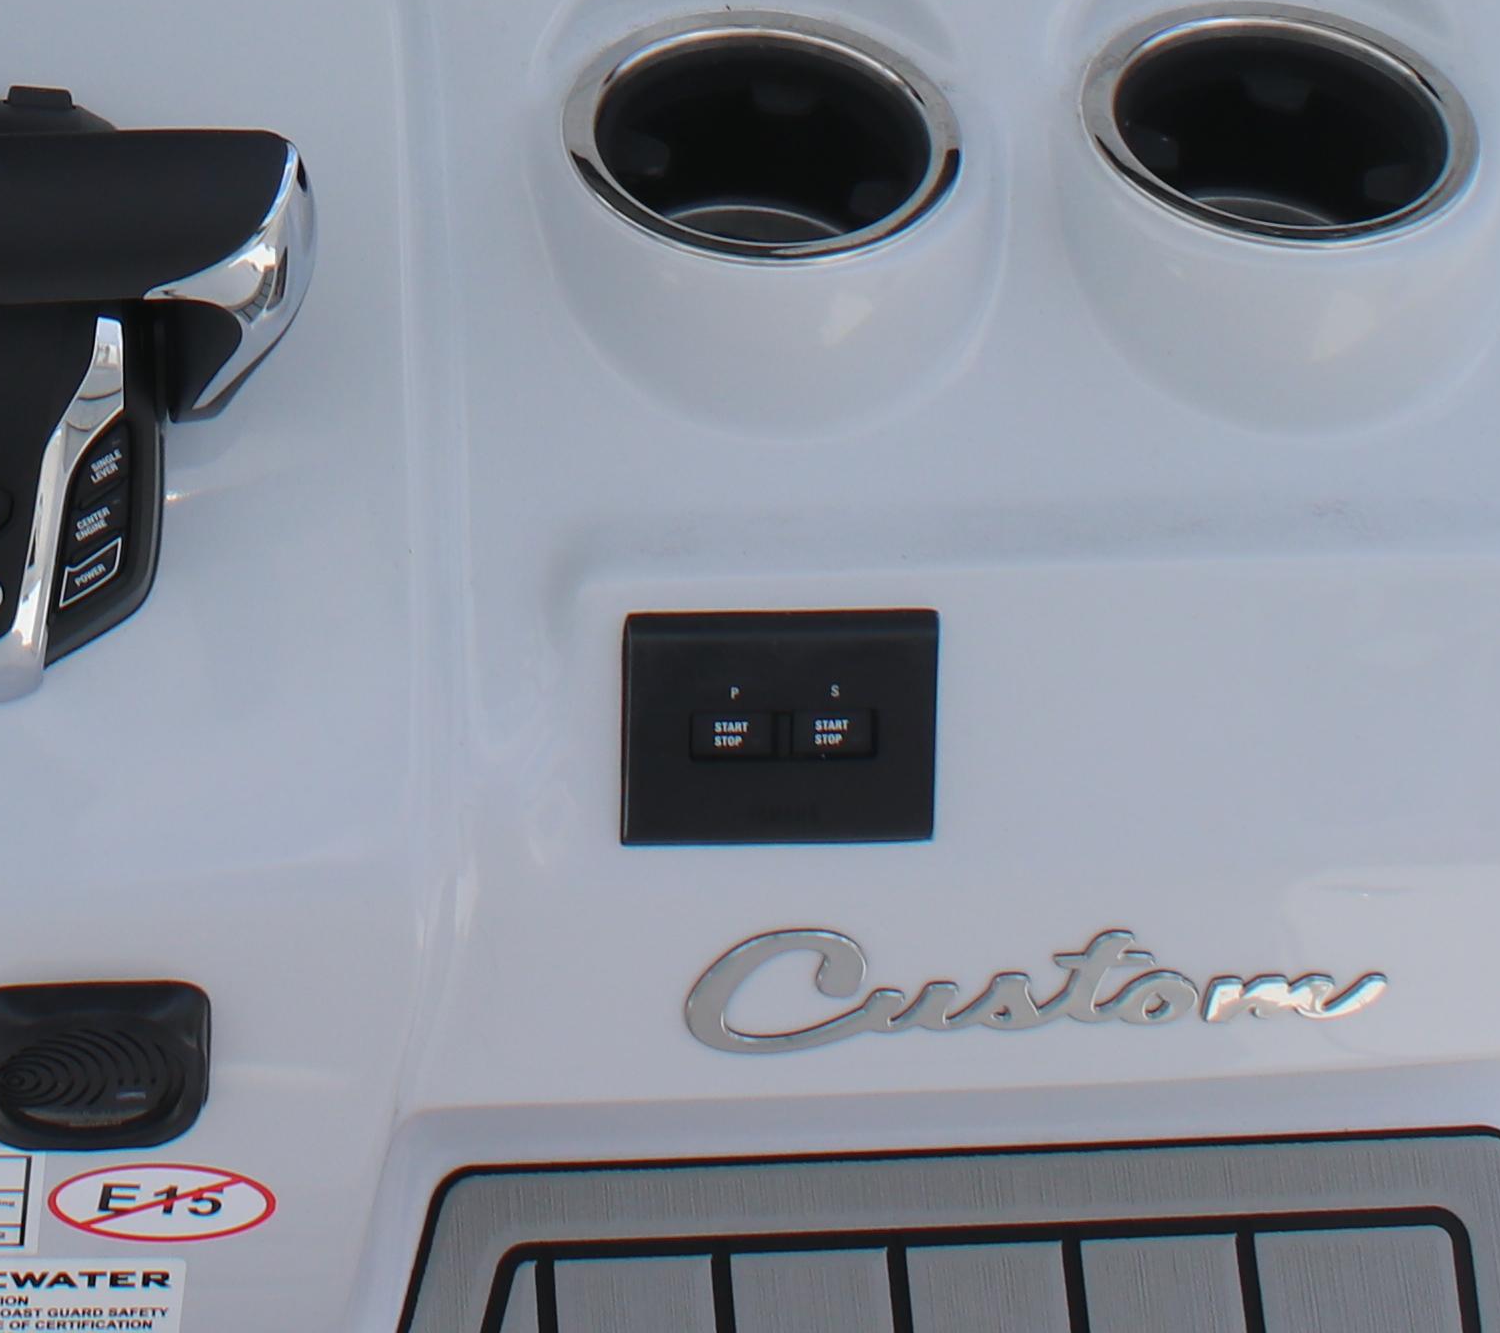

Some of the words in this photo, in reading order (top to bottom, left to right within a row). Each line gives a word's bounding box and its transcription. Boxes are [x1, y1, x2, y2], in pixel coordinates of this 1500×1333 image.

[90, 448, 123, 472] SINGLE
[90, 462, 119, 484] LEVER
[76, 506, 111, 530] CENTER
[74, 519, 108, 542] ENGINE
[74, 563, 107, 587] POWER
[730, 687, 740, 700] P
[830, 684, 840, 697] S
[714, 721, 749, 733] START
[814, 719, 850, 731] START
[714, 735, 743, 747] STOP
[814, 734, 843, 745] STOP
[684, 928, 1389, 1054] Custom
[48, 1307, 103, 1318] GUARD
[108, 1307, 169, 1318] SAFETY
[9, 1320, 31, 1331] OF
[35, 1320, 153, 1331] CERTIFICATION
